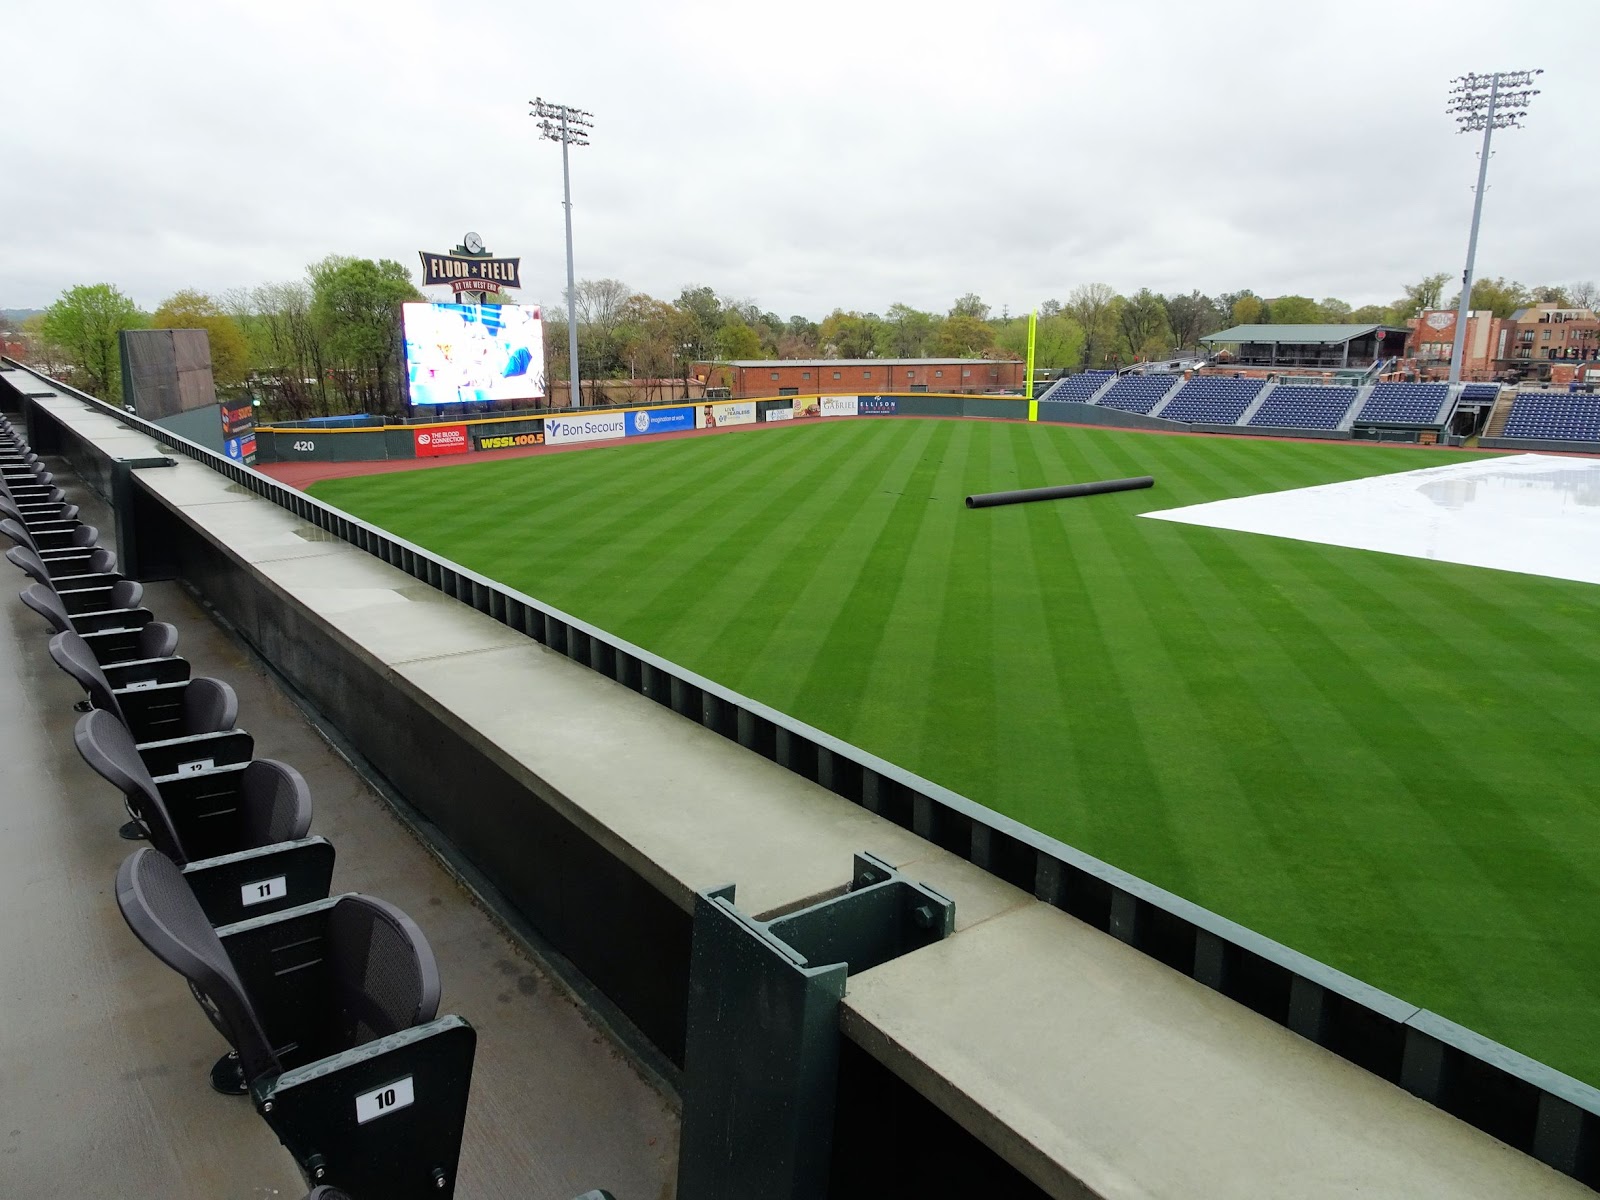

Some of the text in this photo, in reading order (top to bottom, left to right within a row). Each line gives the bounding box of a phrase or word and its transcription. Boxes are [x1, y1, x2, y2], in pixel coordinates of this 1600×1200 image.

[430, 259, 515, 280] FLUOR FIELD
[455, 281, 497, 291] AT THE WEST END
[823, 401, 856, 410] GABRIEL
[562, 421, 624, 436] Bon Secours
[293, 441, 315, 451] 420
[431, 436, 465, 444] CONNECTION
[257, 883, 271, 898] 11
[375, 1089, 395, 1109] 10
